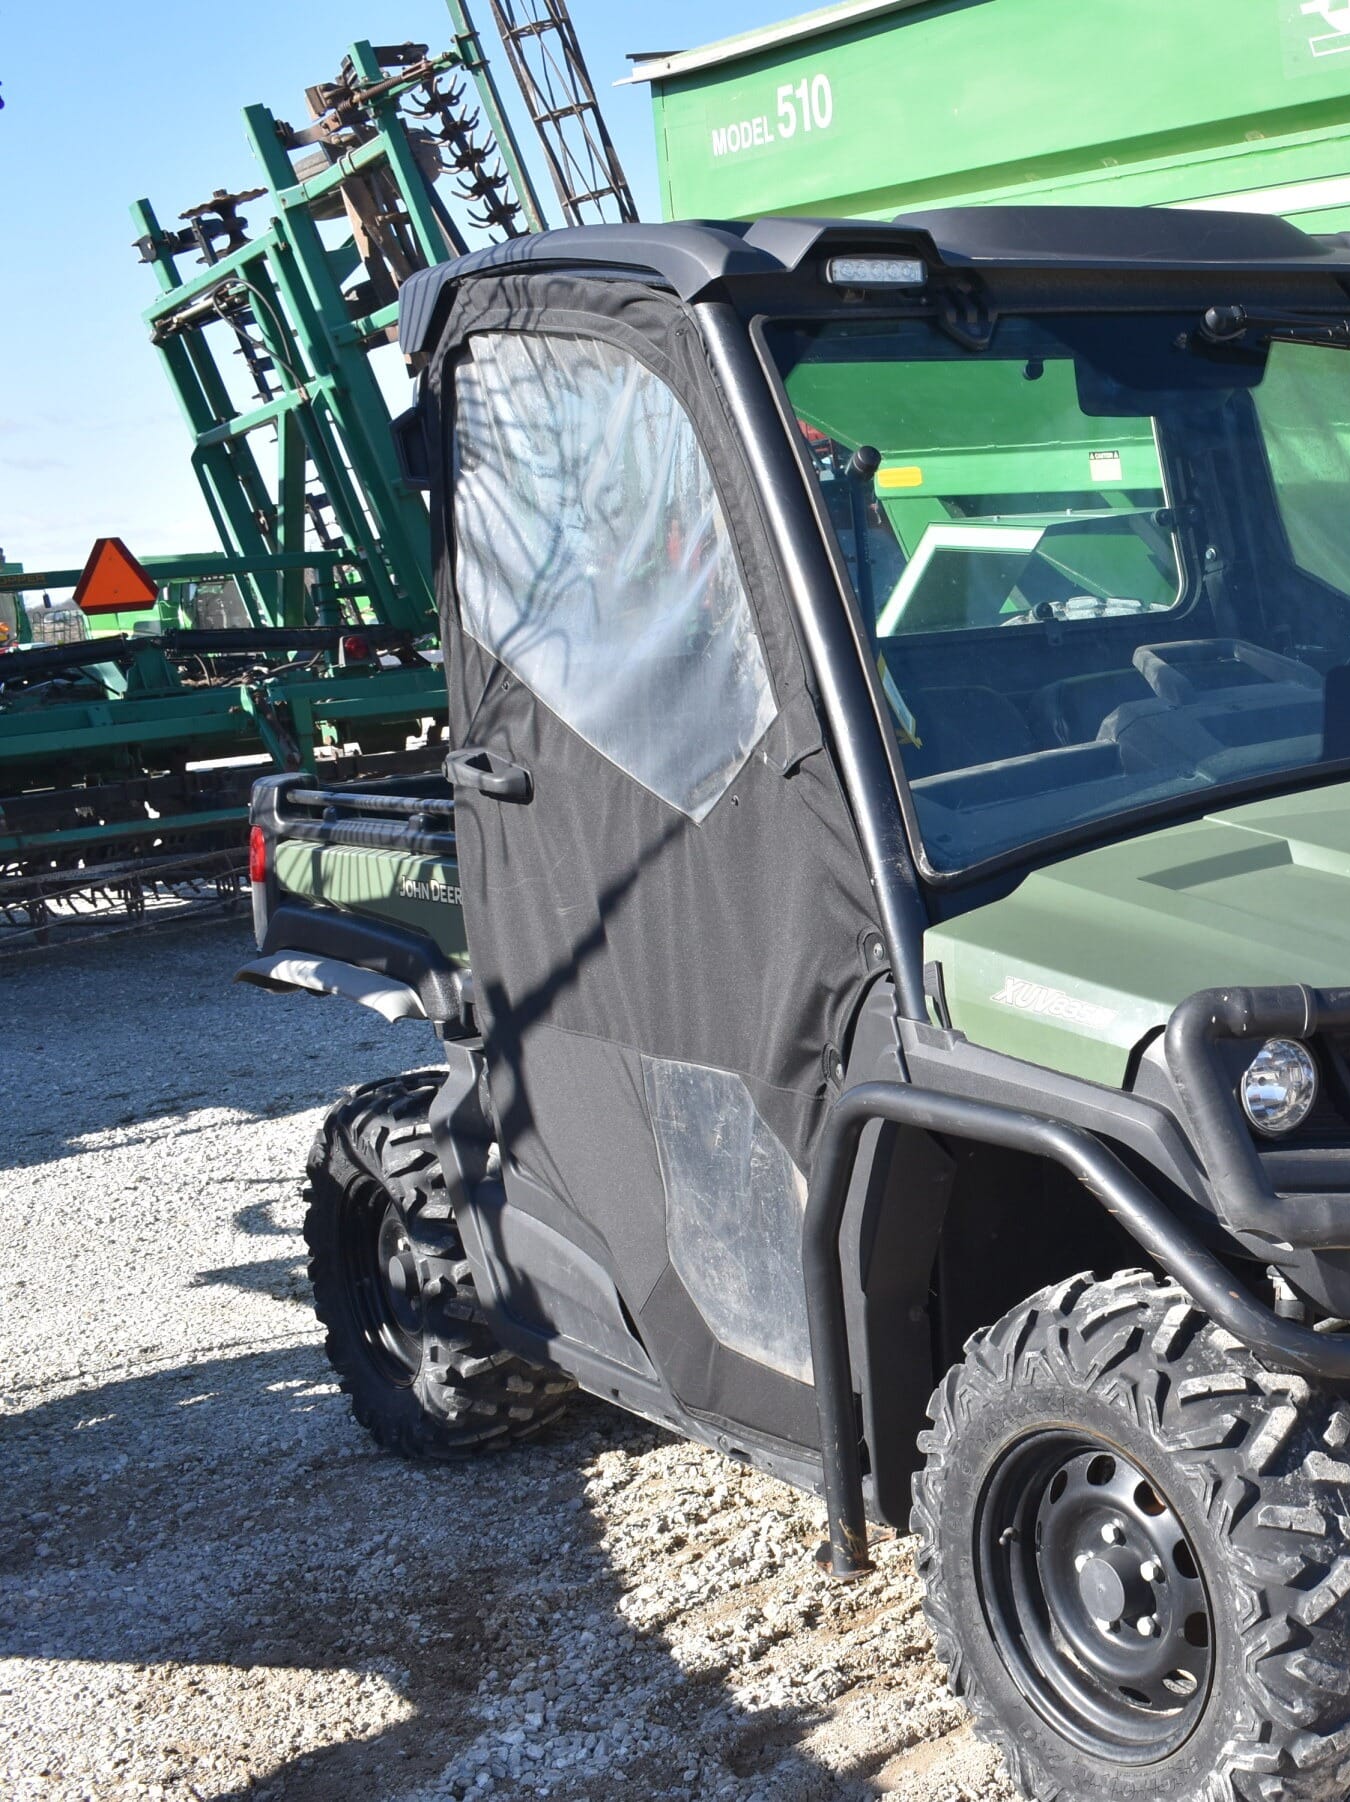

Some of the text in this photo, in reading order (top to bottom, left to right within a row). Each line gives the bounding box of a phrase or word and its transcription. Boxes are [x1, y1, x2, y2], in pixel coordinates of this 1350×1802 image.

[711, 73, 833, 157] MODEL 510
[400, 876, 463, 905] JOHN DEER
